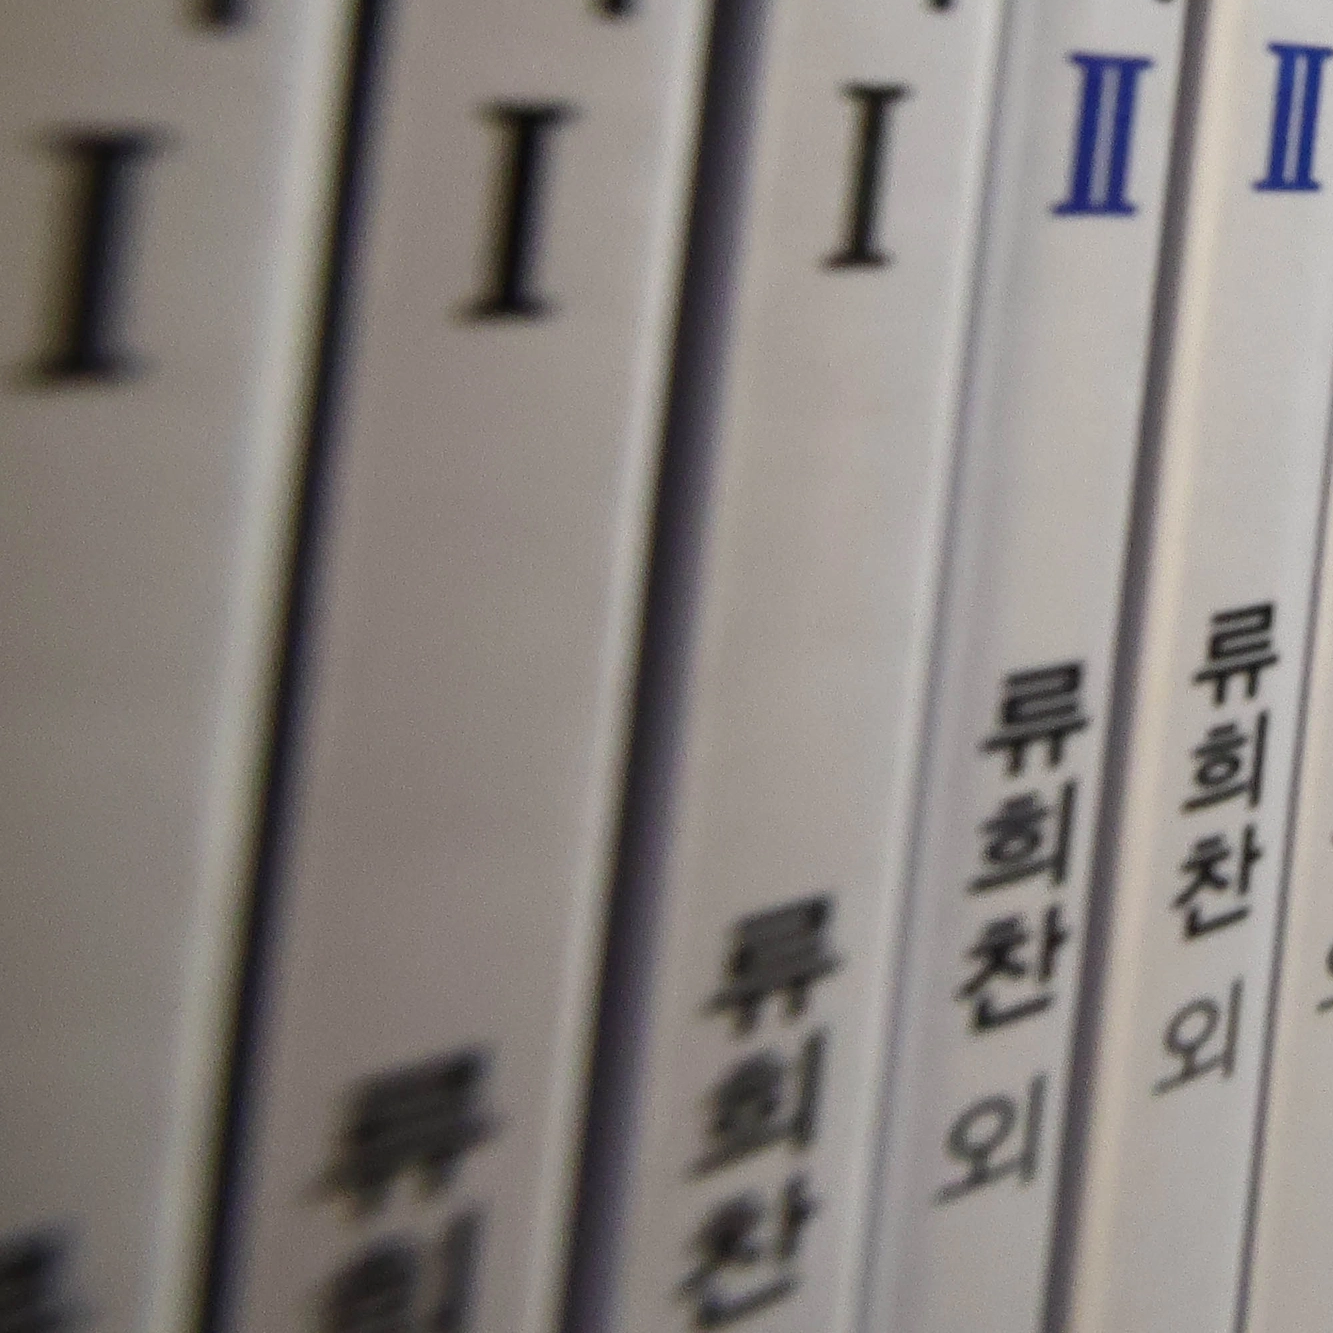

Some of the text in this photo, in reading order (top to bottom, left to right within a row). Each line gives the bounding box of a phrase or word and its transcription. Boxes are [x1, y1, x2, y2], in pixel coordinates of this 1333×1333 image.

[932, 659, 1088, 1207] 류희찬 외
[1152, 602, 1278, 1098] 류희찬 외
